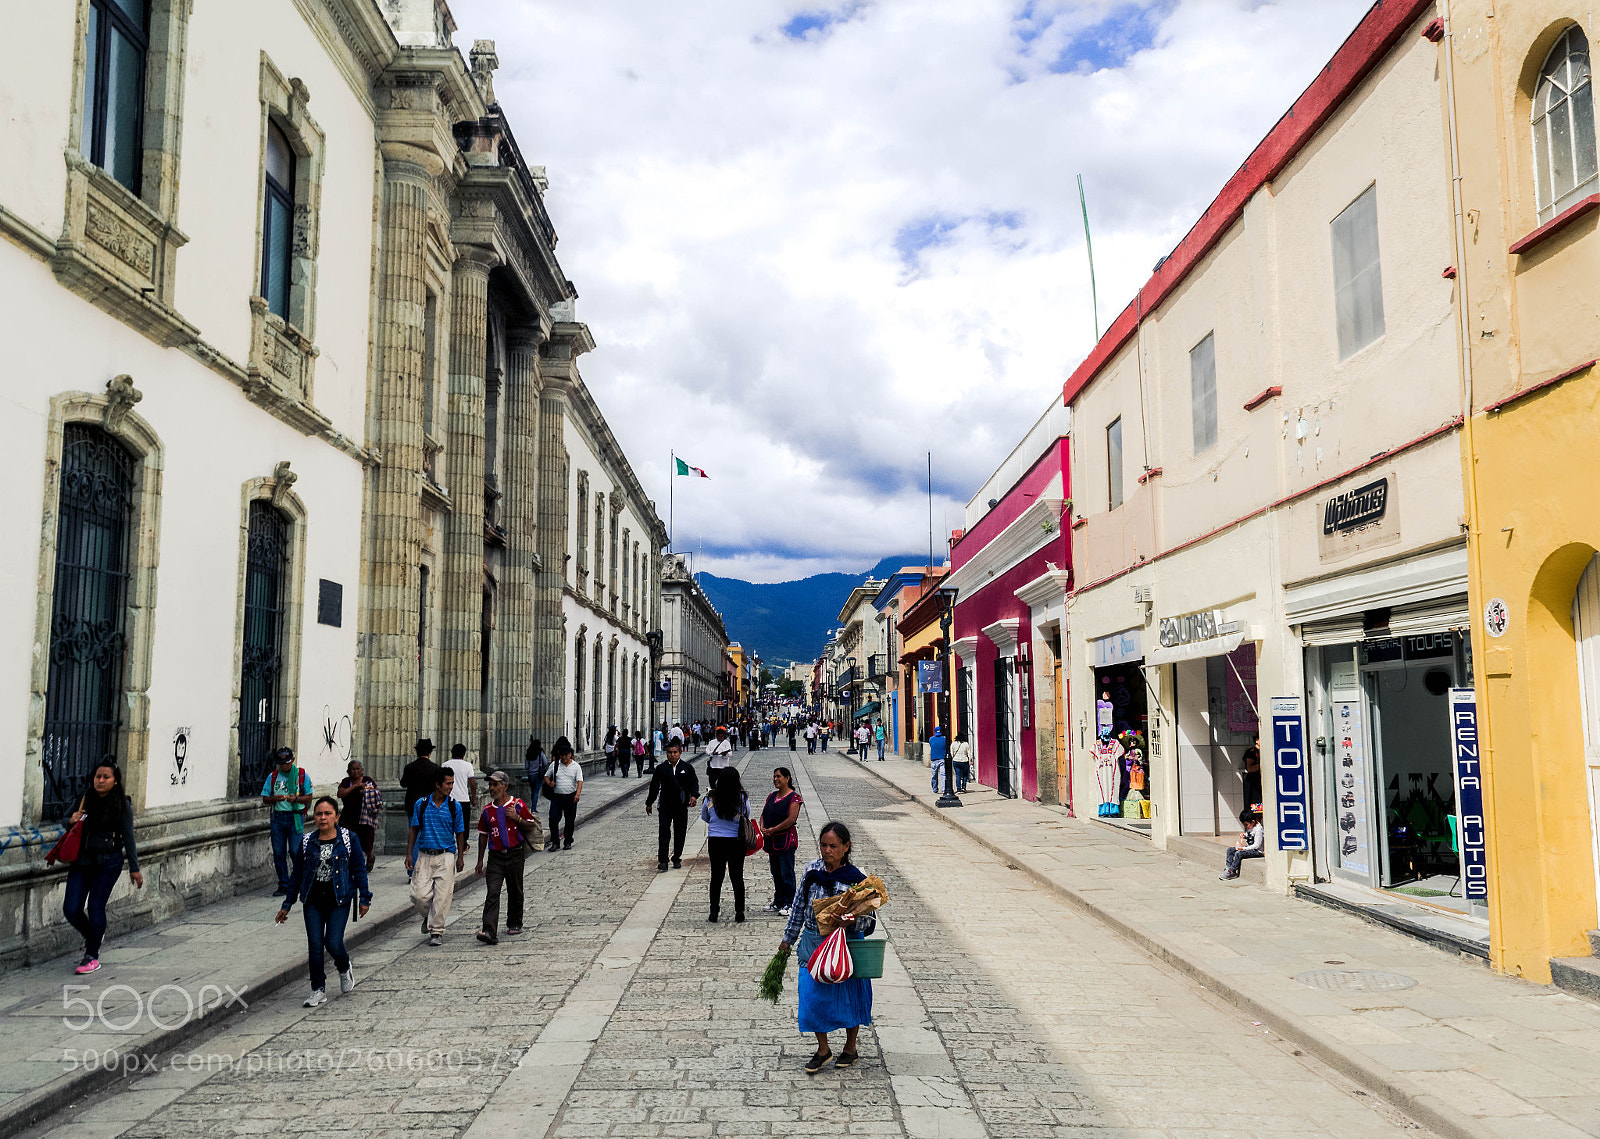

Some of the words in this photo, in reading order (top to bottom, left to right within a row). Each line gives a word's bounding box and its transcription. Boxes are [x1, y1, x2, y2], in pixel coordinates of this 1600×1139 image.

[1170, 610, 1221, 643] NUTRISA
[1408, 632, 1453, 651] TOURS
[1275, 720, 1306, 850] TOURS
[1455, 711, 1480, 790] RENTA
[1463, 814, 1487, 896] AUTOS
